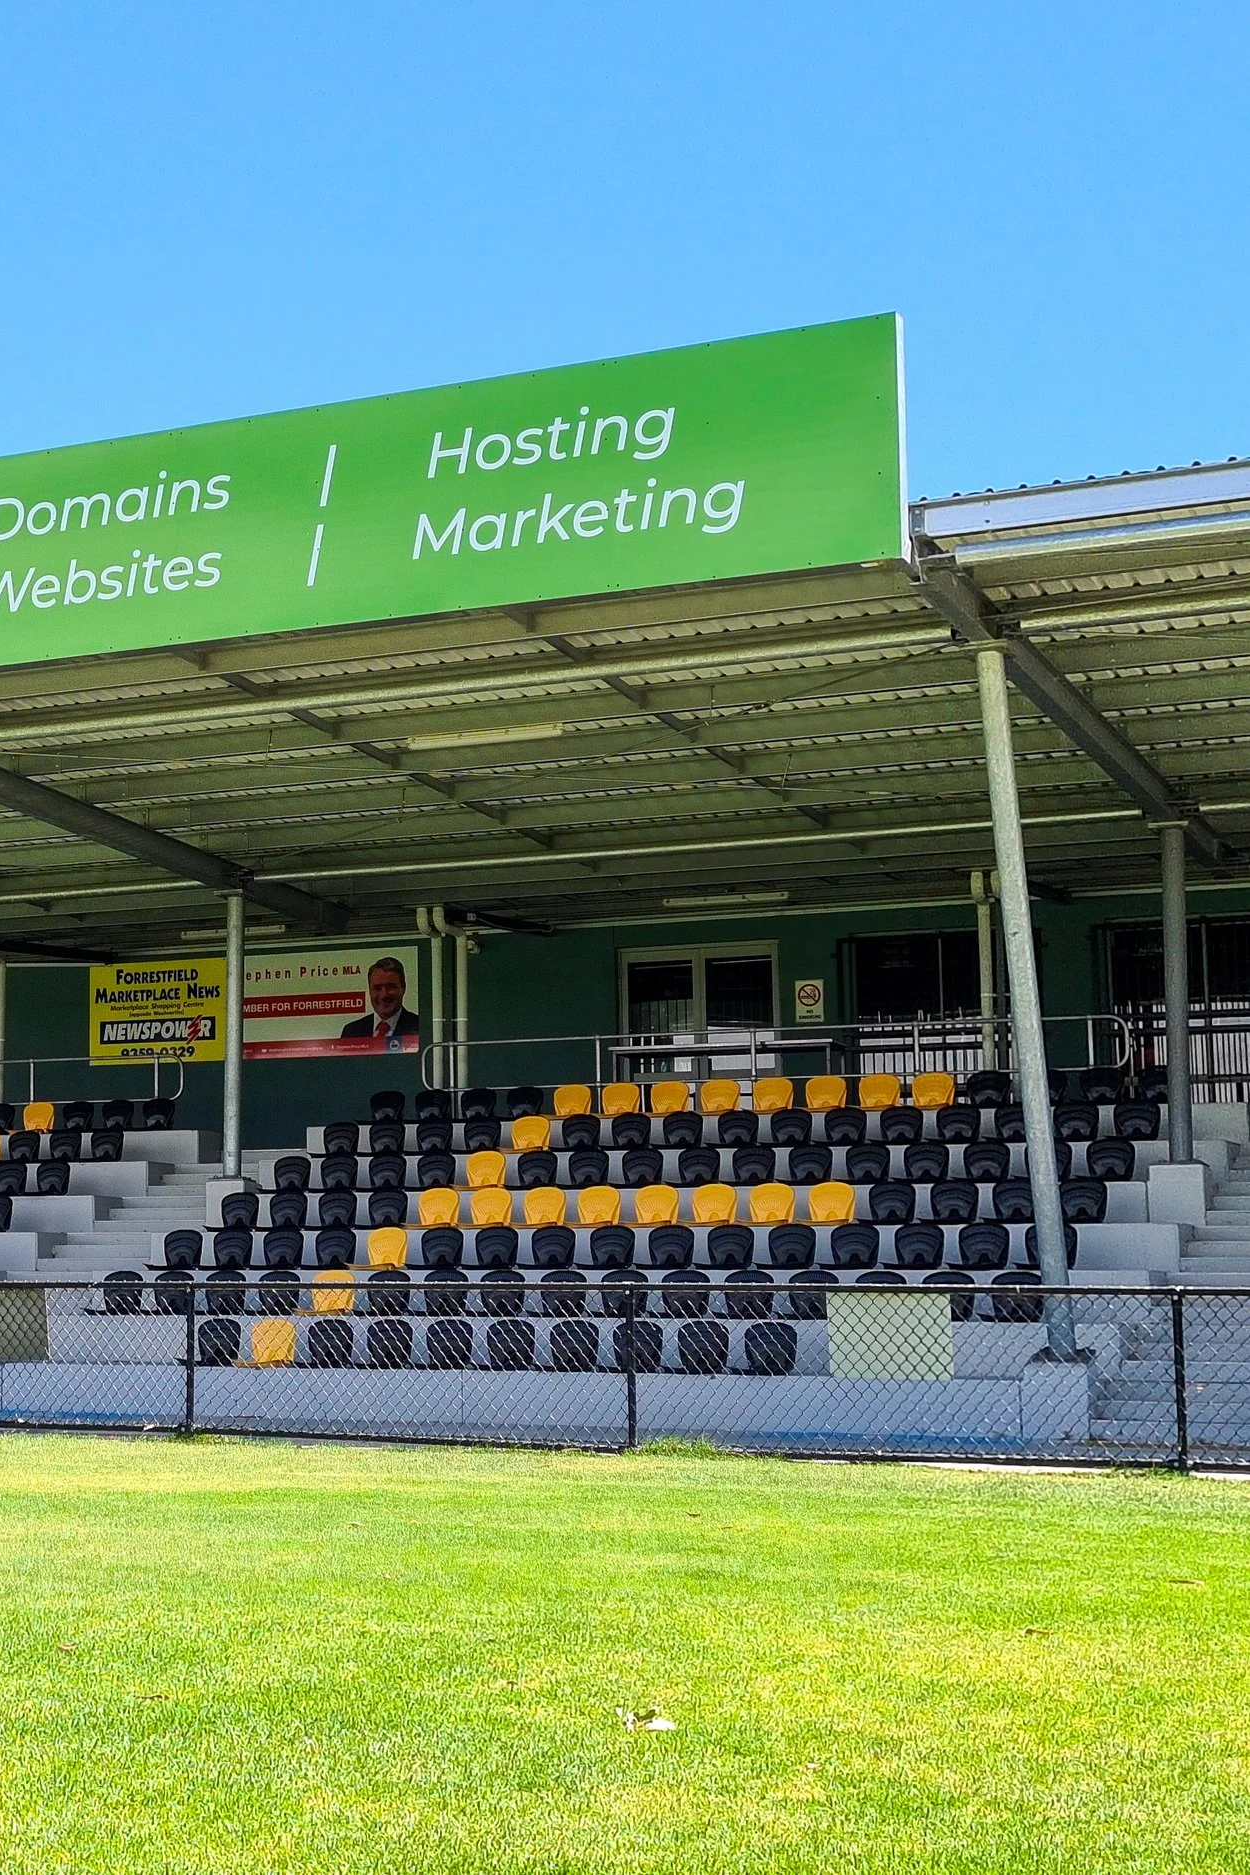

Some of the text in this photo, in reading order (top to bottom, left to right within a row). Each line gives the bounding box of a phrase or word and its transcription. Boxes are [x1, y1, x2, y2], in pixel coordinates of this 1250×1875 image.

[427, 407, 676, 479] Hosting
[412, 478, 745, 560] Marketing
[246, 965, 361, 982] ephen Price MLA
[187, 983, 220, 999] NEWS
[110, 1004, 148, 1012] Marketplace
[151, 1002, 180, 1010] Shopping
[243, 999, 363, 1014] MBER FOR FORRESTFIELD
